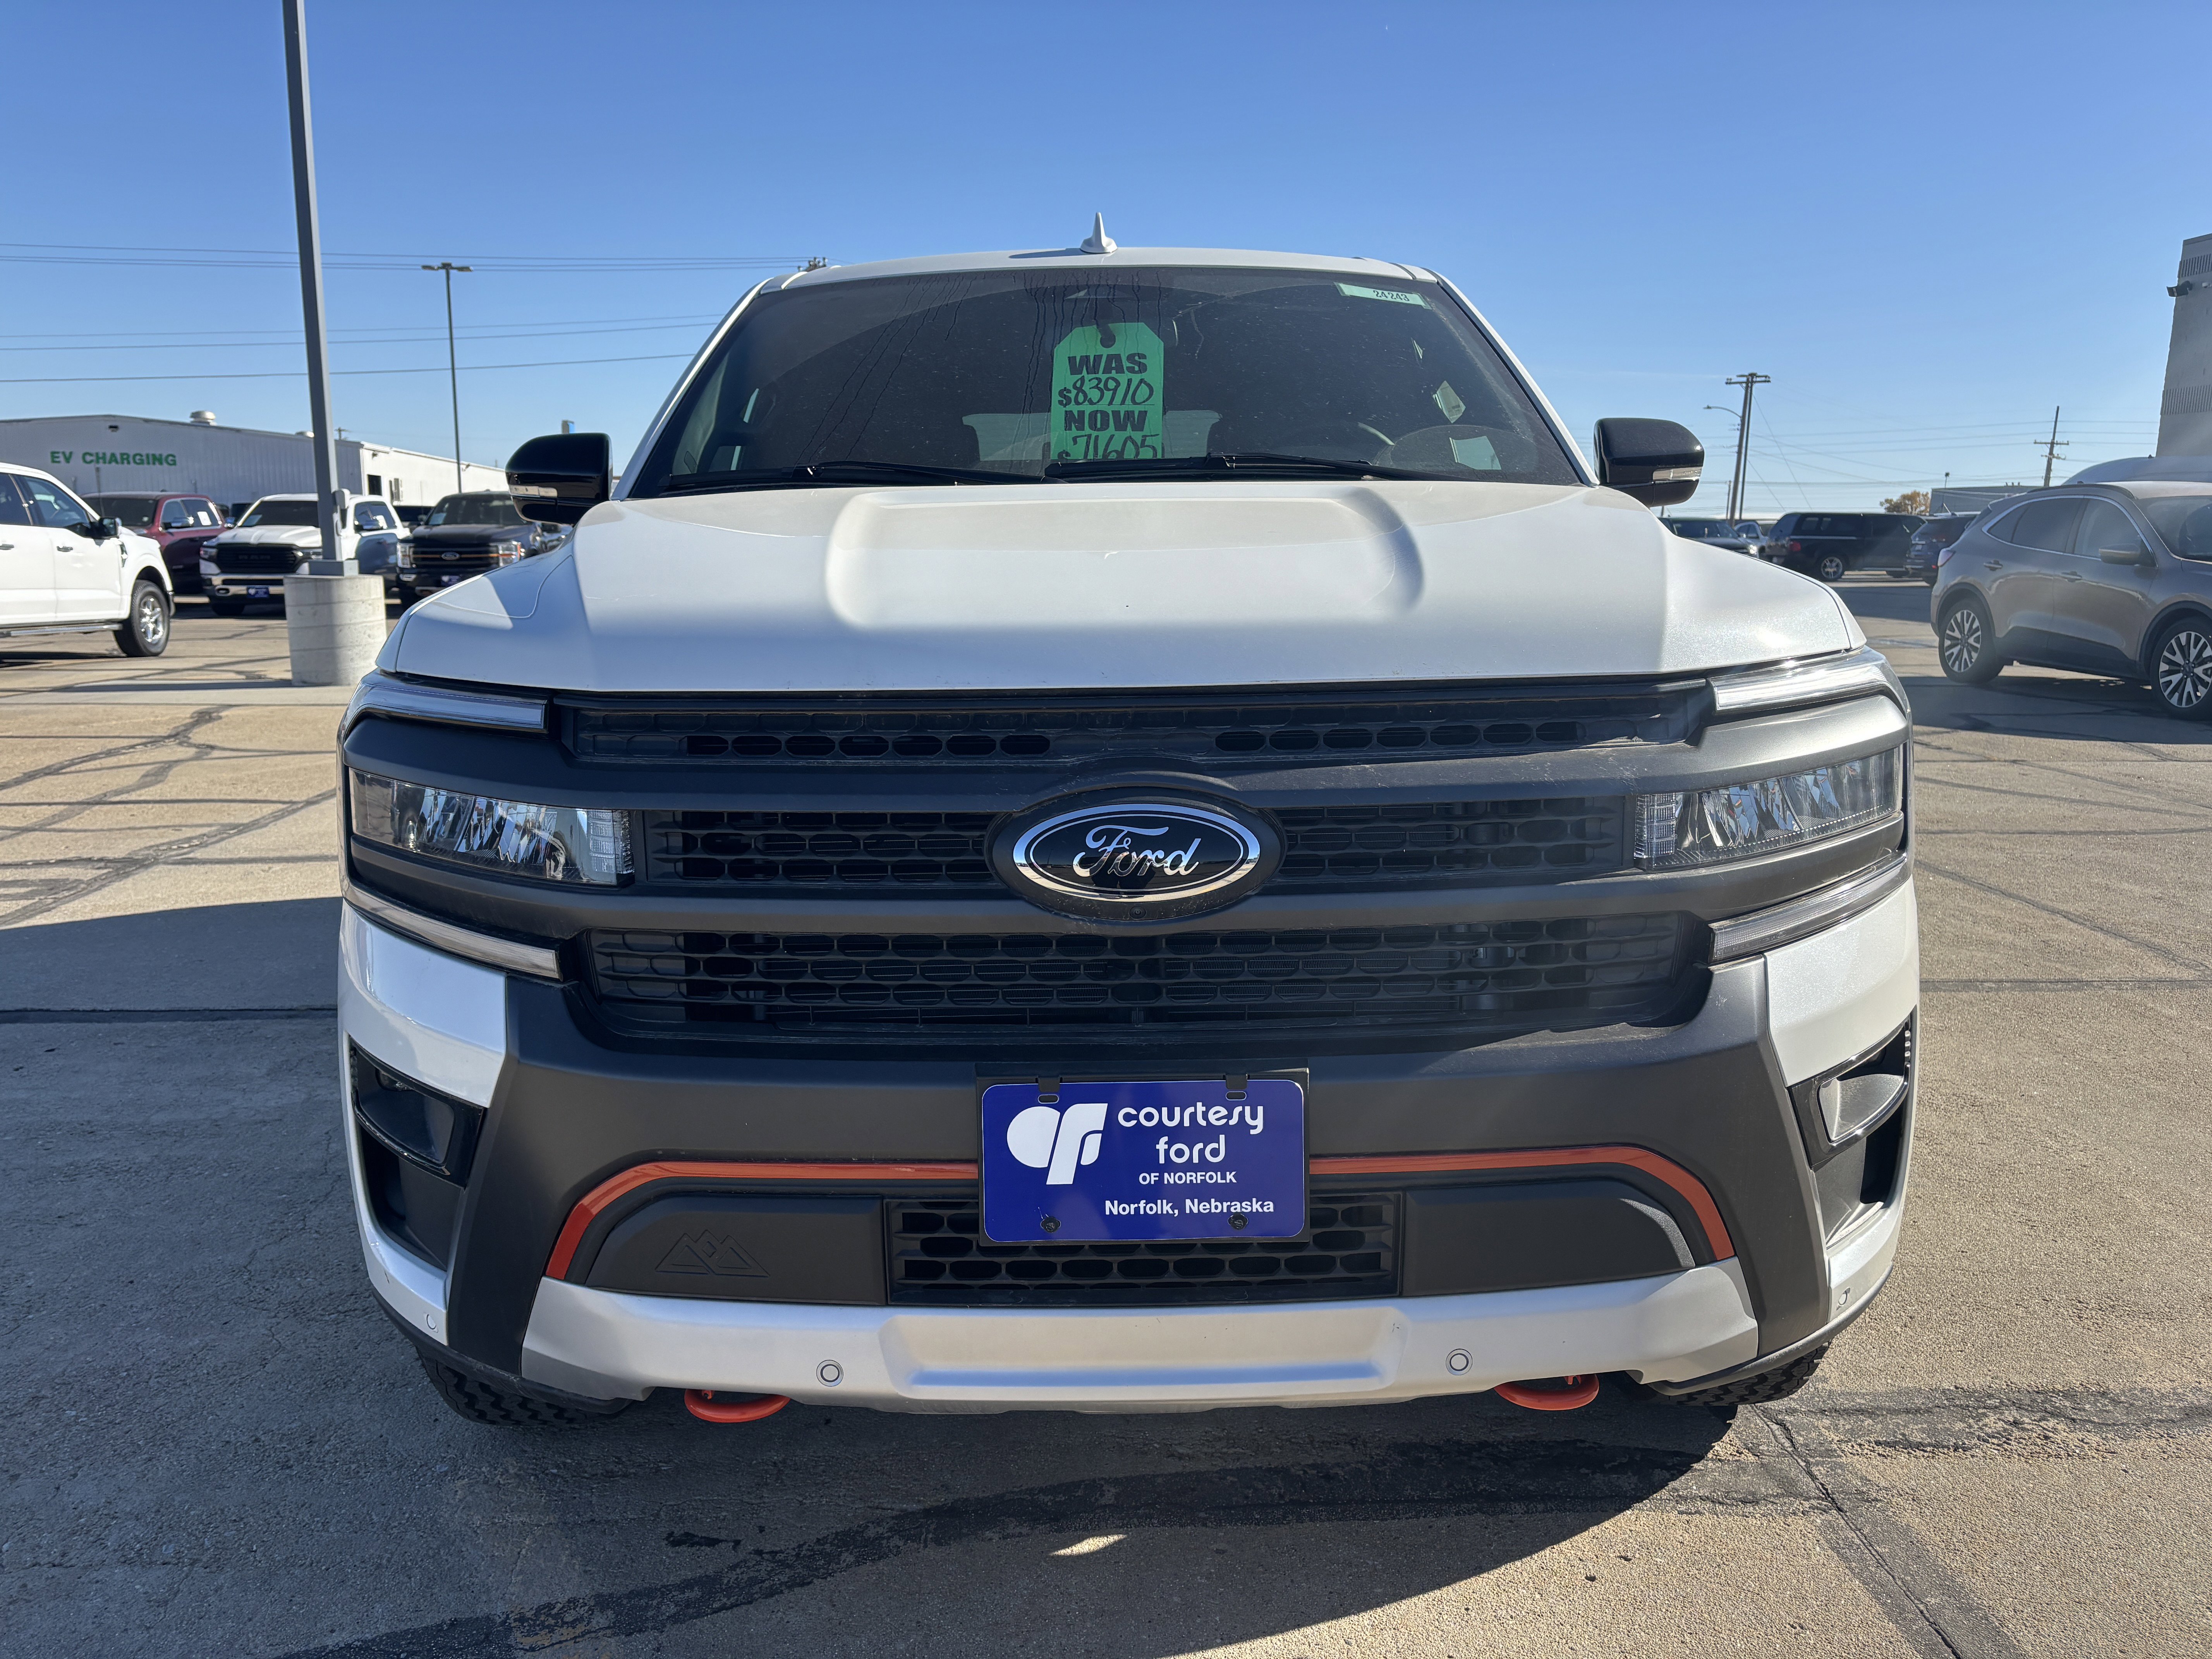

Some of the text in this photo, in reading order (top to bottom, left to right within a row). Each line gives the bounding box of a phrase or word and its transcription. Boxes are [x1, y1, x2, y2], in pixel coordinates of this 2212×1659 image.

[1067, 353, 1147, 375] WAS
[1064, 410, 1148, 432] NOW
[50, 451, 176, 466] EV CHARGING
[1073, 825, 1201, 877] Ford
[1118, 1102, 1264, 1135] courtesy
[1156, 1135, 1225, 1164] ford
[1139, 1171, 1237, 1185] OF NORFOLK
[1105, 1198, 1274, 1217] Norfolk, Nebraska
